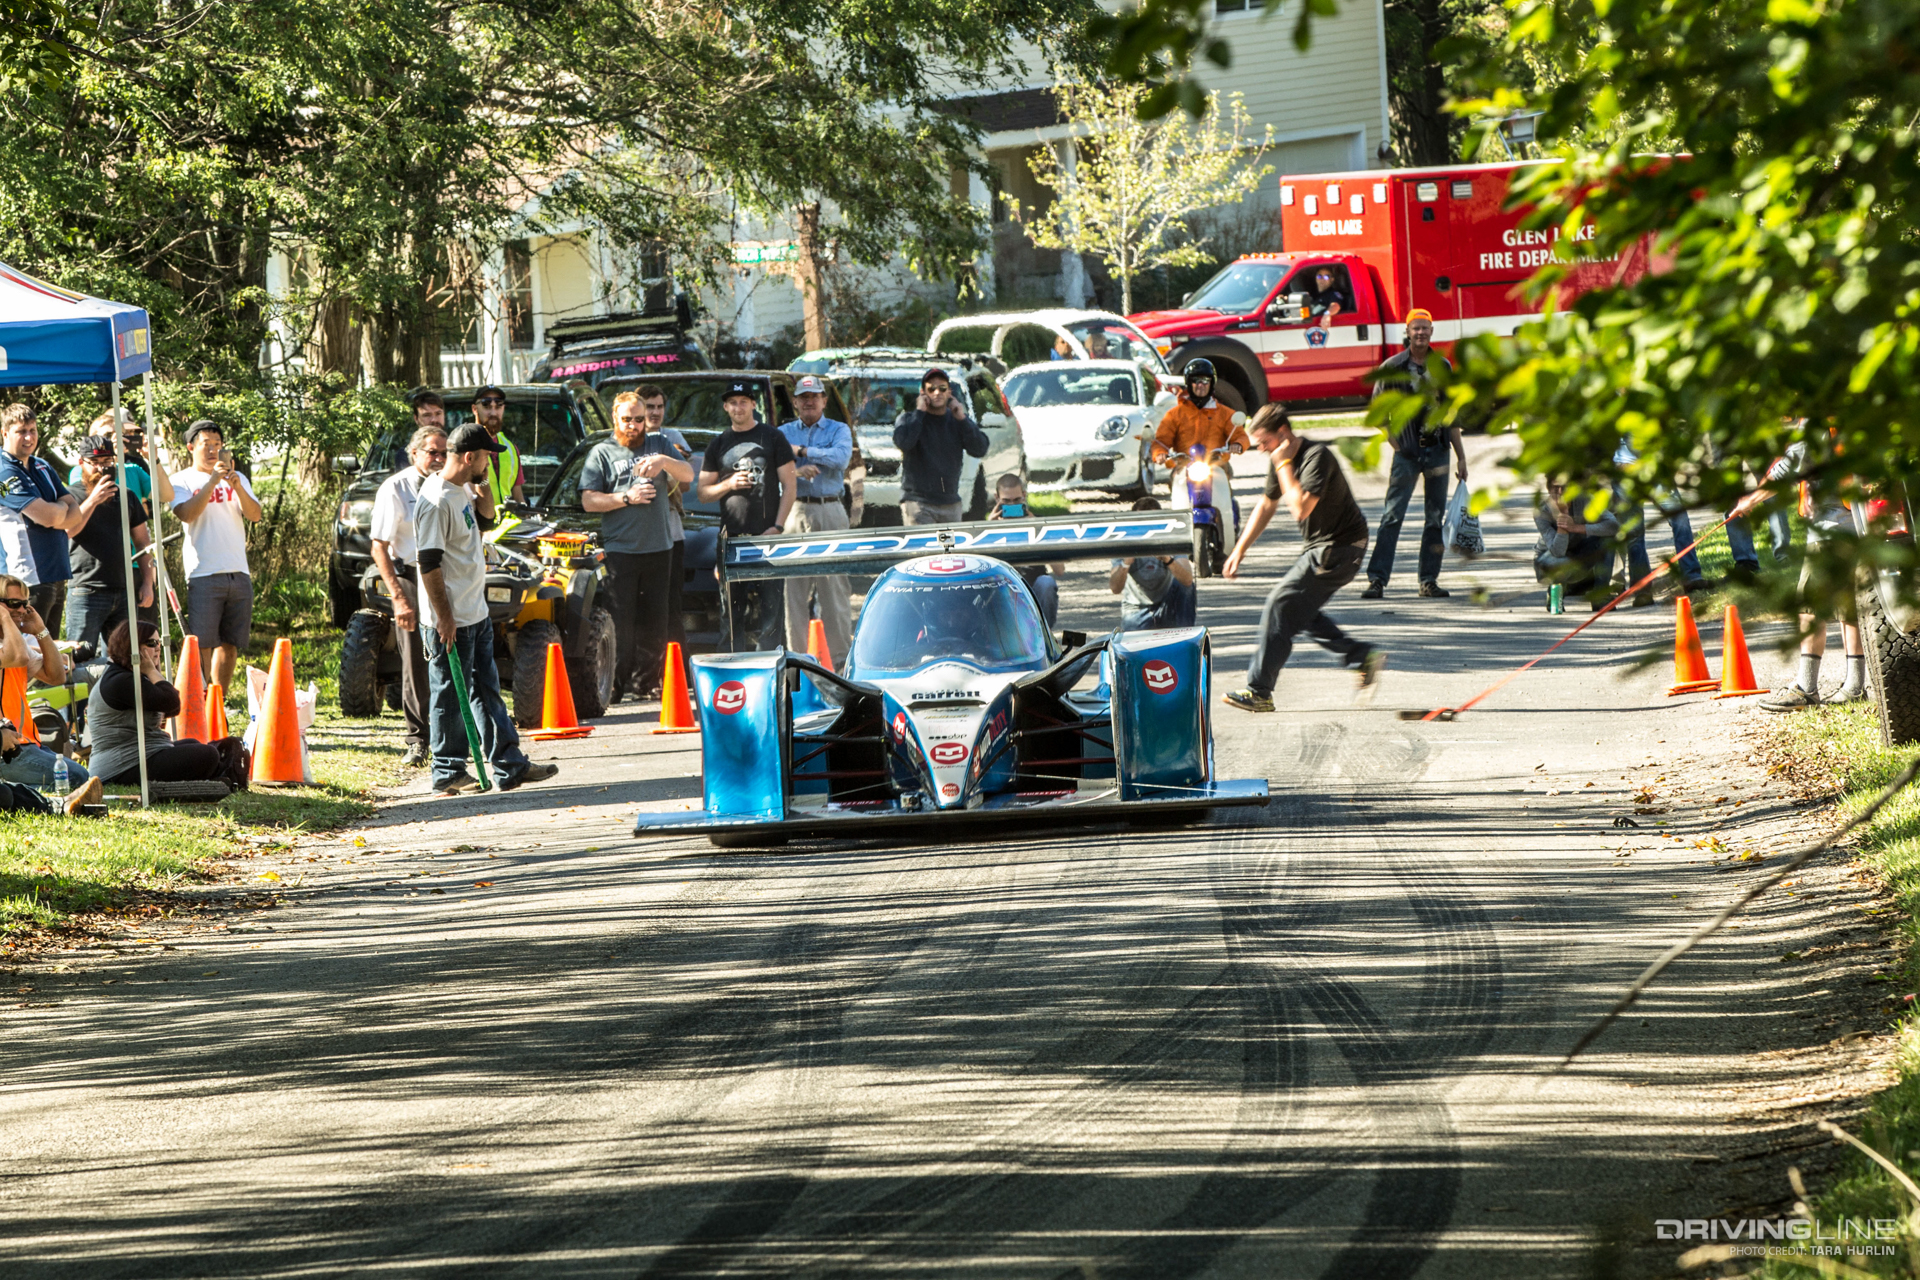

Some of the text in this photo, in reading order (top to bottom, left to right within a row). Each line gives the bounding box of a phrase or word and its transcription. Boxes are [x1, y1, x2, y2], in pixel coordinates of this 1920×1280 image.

[1310, 219, 1363, 236] GLEN LAKE
[1502, 229, 1547, 246] GLEN
[1480, 249, 1619, 270] FIRE DEPAMT
[550, 353, 681, 378] RANDOM TASK
